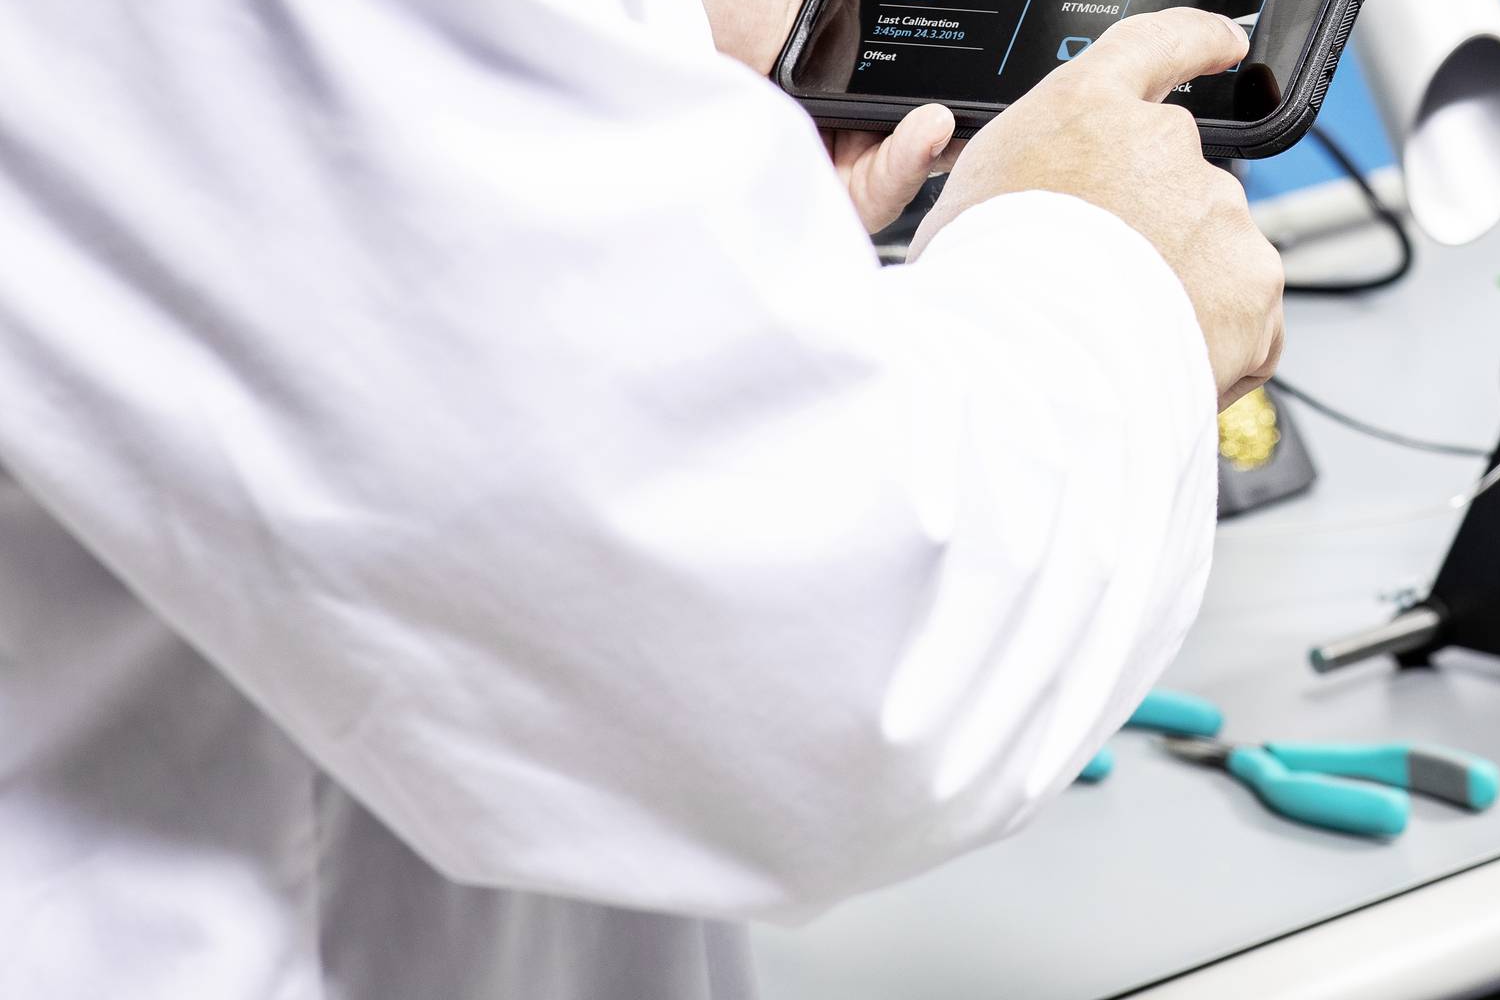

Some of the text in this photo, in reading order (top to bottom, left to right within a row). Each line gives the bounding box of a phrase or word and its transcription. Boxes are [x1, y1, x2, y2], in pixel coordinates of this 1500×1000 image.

[1061, 2, 1120, 15] RTM004B
[878, 14, 960, 29] Last Calibration
[872, 25, 965, 41] 3:45pm 24.3.2019
[863, 50, 897, 61] Offset
